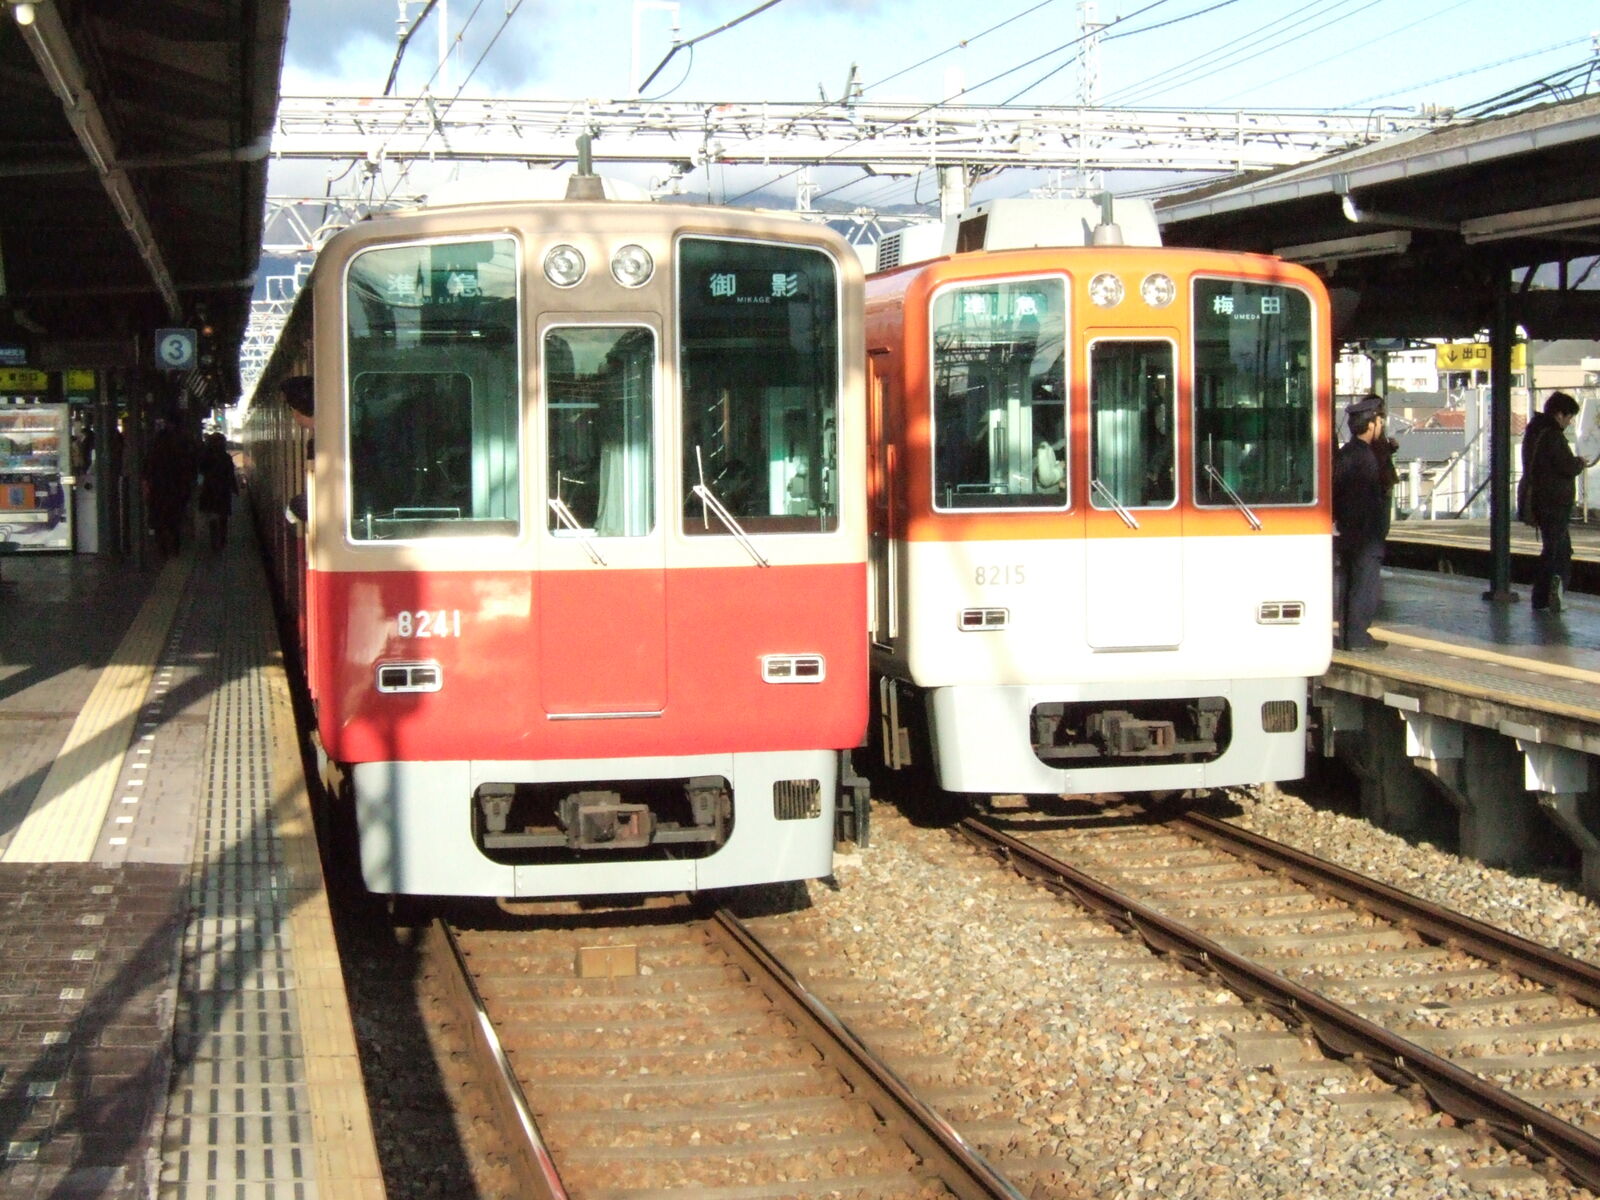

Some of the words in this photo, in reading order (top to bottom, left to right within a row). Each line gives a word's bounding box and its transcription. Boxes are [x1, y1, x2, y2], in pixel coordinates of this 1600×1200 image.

[709, 272, 798, 297] 御影
[736, 296, 771, 304] MIKAGE
[1213, 295, 1281, 315] 梅田
[168, 340, 184, 360] 3
[1462, 347, 1487, 360] 出口
[975, 564, 1025, 586] 8215
[398, 609, 461, 638] 8241
